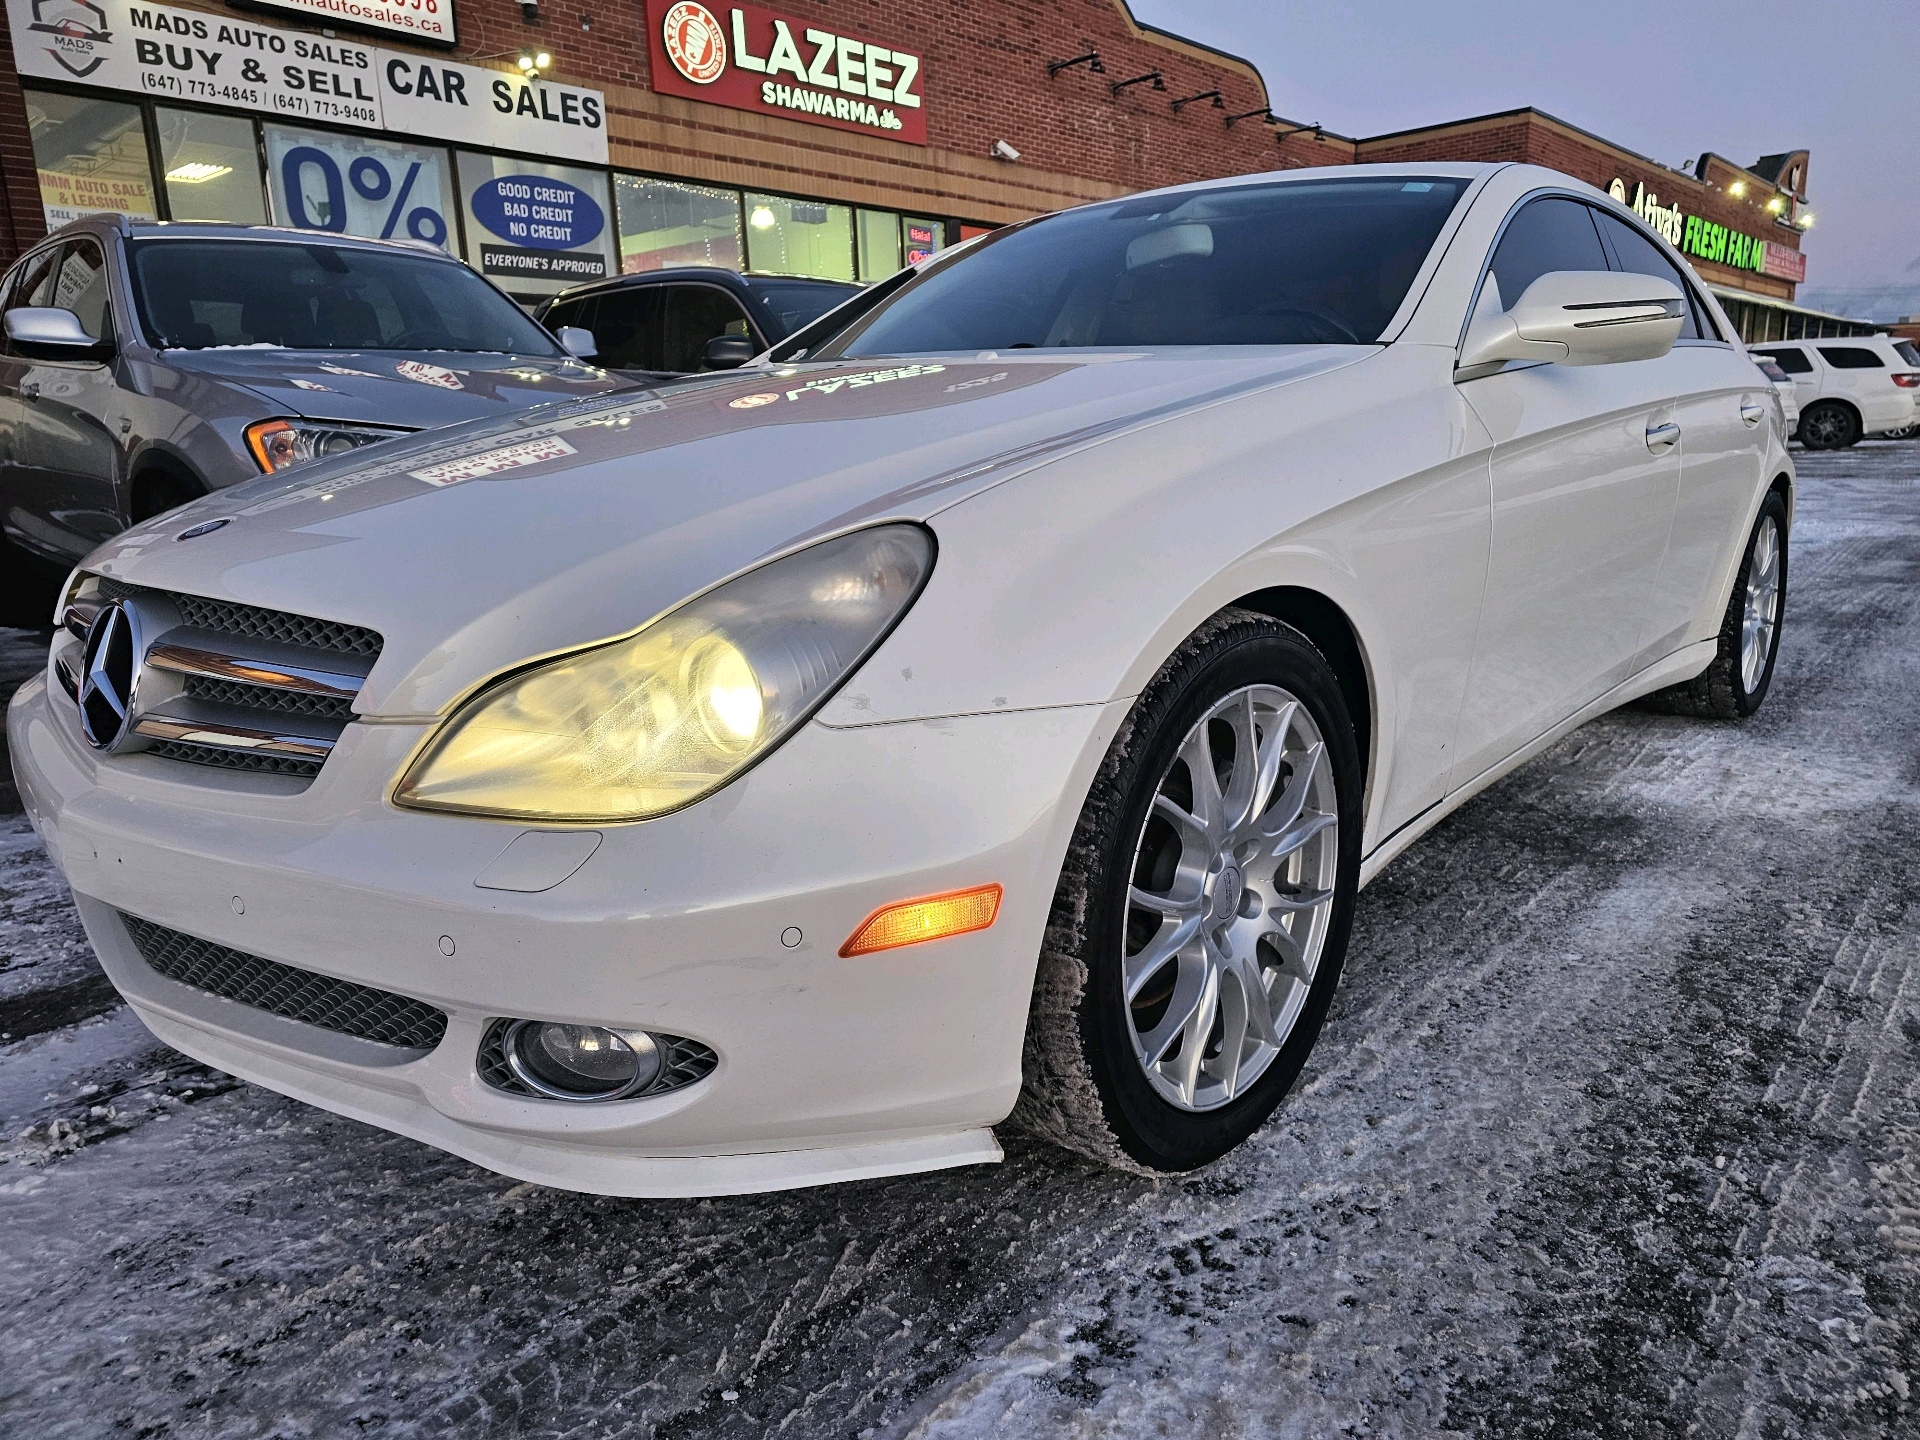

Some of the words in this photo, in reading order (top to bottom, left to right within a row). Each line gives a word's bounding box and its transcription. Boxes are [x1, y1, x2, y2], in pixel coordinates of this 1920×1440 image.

[289, 0, 443, 34] autosales.ca
[667, 5, 689, 59] LAZEEZ
[54, 36, 94, 50] MADS
[130, 8, 208, 39] MADS
[217, 25, 286, 54] AUTO
[294, 40, 369, 69] SALES
[731, 8, 921, 109] LAZEEZ
[135, 38, 222, 76] BUY
[241, 58, 268, 84] &
[283, 65, 374, 102] SELL
[141, 72, 182, 95] (647)
[188, 79, 257, 104] 773-4845
[273, 93, 309, 115] (647)
[314, 100, 376, 122] 773-9408
[386, 59, 469, 106] CAR
[492, 79, 602, 129] SALES
[762, 81, 880, 127] SHAWARMA
[59, 192, 69, 205] &
[72, 193, 130, 210] LEASING
[75, 179, 109, 195] AUTO
[112, 183, 146, 197] SALE
[282, 146, 447, 247] 0%
[498, 181, 531, 199] GOOD
[533, 186, 575, 205] CREDIT
[503, 201, 529, 218] BAD
[532, 205, 573, 223] CREDIT
[509, 221, 528, 237] NO
[530, 224, 572, 241] CREDIT
[910, 228, 931, 242] Halal
[1683, 214, 1728, 263] FRESH
[1726, 230, 1764, 273] FARM
[484, 252, 549, 270] EVERYONE'S
[550, 258, 604, 275] APPROVED
